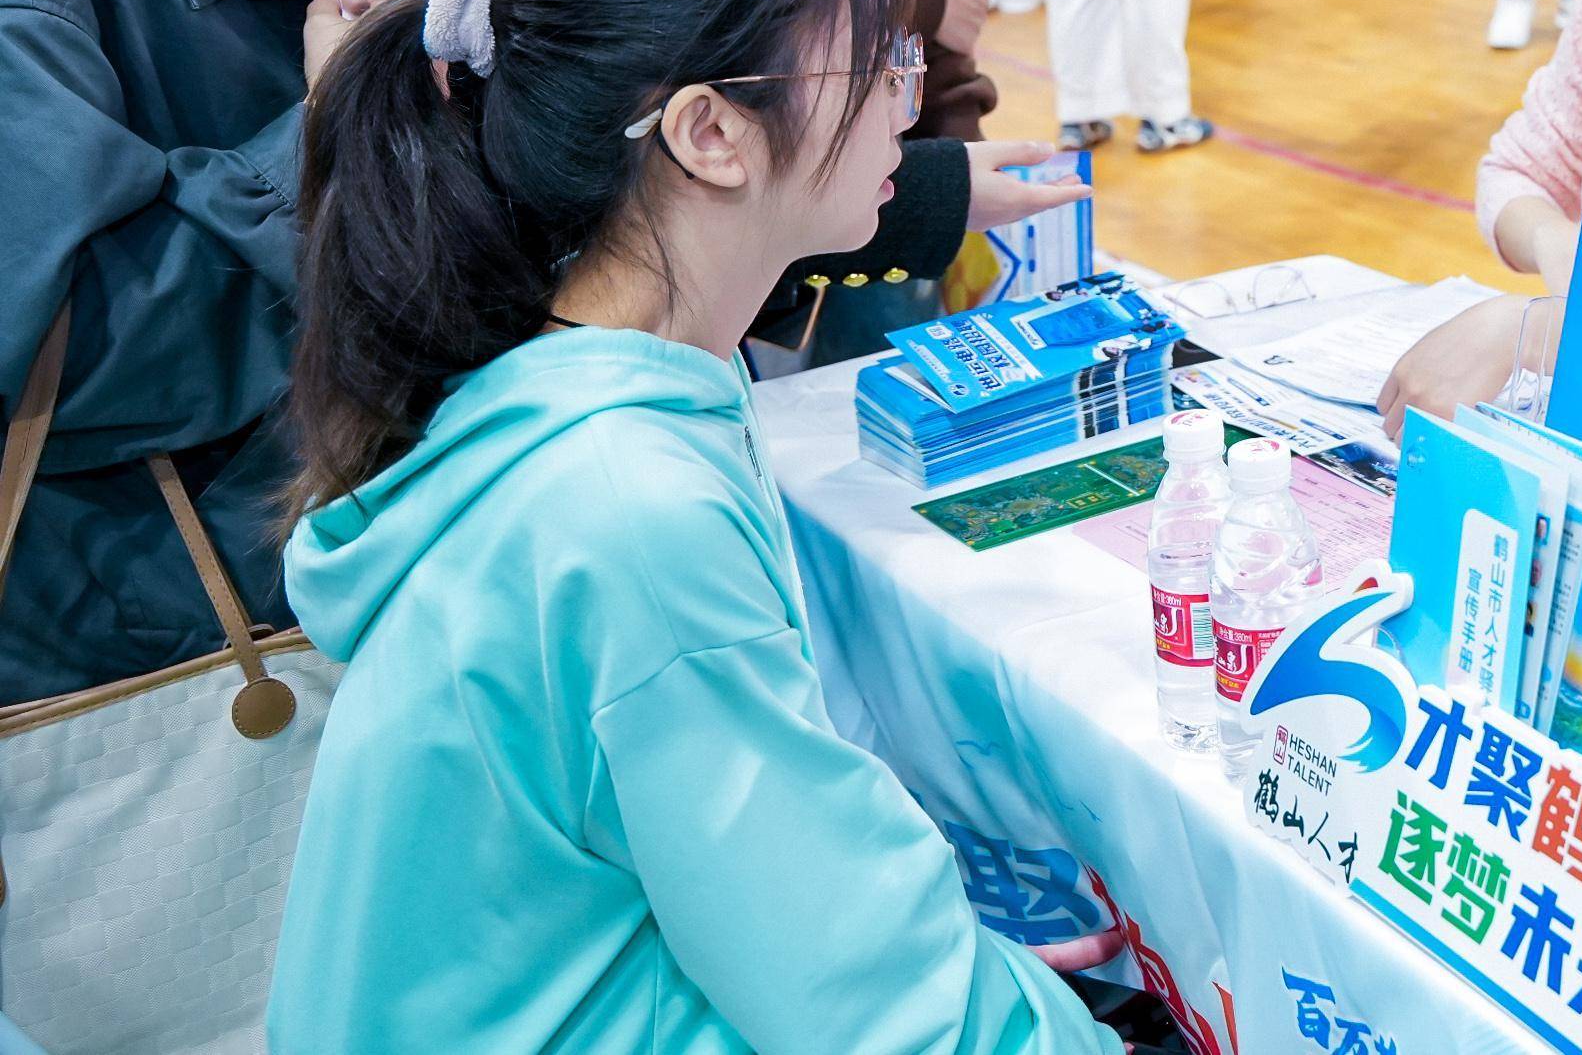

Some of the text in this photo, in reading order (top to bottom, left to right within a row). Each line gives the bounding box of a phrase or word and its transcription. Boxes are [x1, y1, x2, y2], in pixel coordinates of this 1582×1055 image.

[1287, 753, 1332, 797] TALENT
[1289, 733, 1337, 778] HESHAN
[1254, 768, 1358, 884] 鹤山人才
